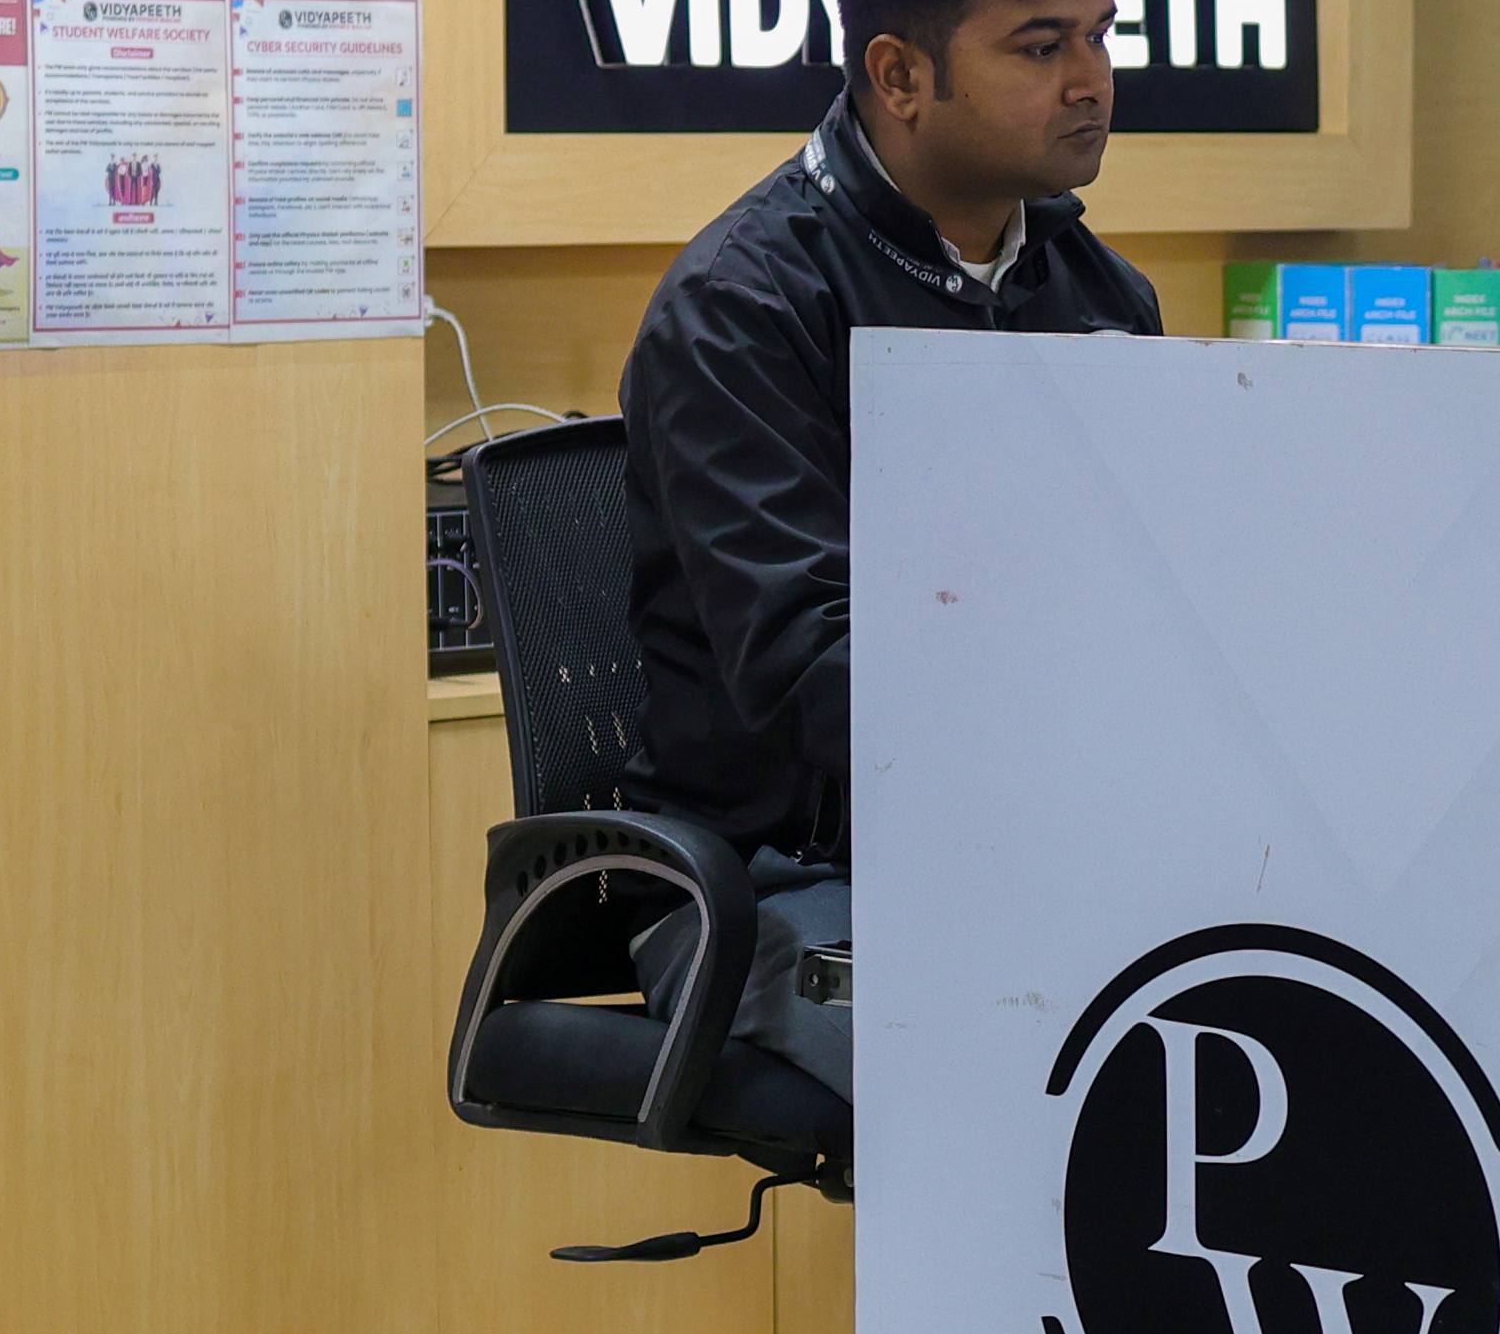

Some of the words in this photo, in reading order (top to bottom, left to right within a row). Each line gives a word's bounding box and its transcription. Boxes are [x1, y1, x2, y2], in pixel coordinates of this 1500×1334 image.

[100, 3, 181, 17] VIDYAPEETH
[295, 12, 371, 24] VIDYAPEETH
[52, 27, 103, 38] STUDENT
[107, 28, 160, 39] WELFARE
[164, 29, 210, 41] SOCIETY
[247, 41, 282, 52] CYBER
[285, 42, 336, 53] SECURITY
[340, 43, 402, 54] GUIDELINES
[868, 232, 940, 286] VIDYAPEETH
